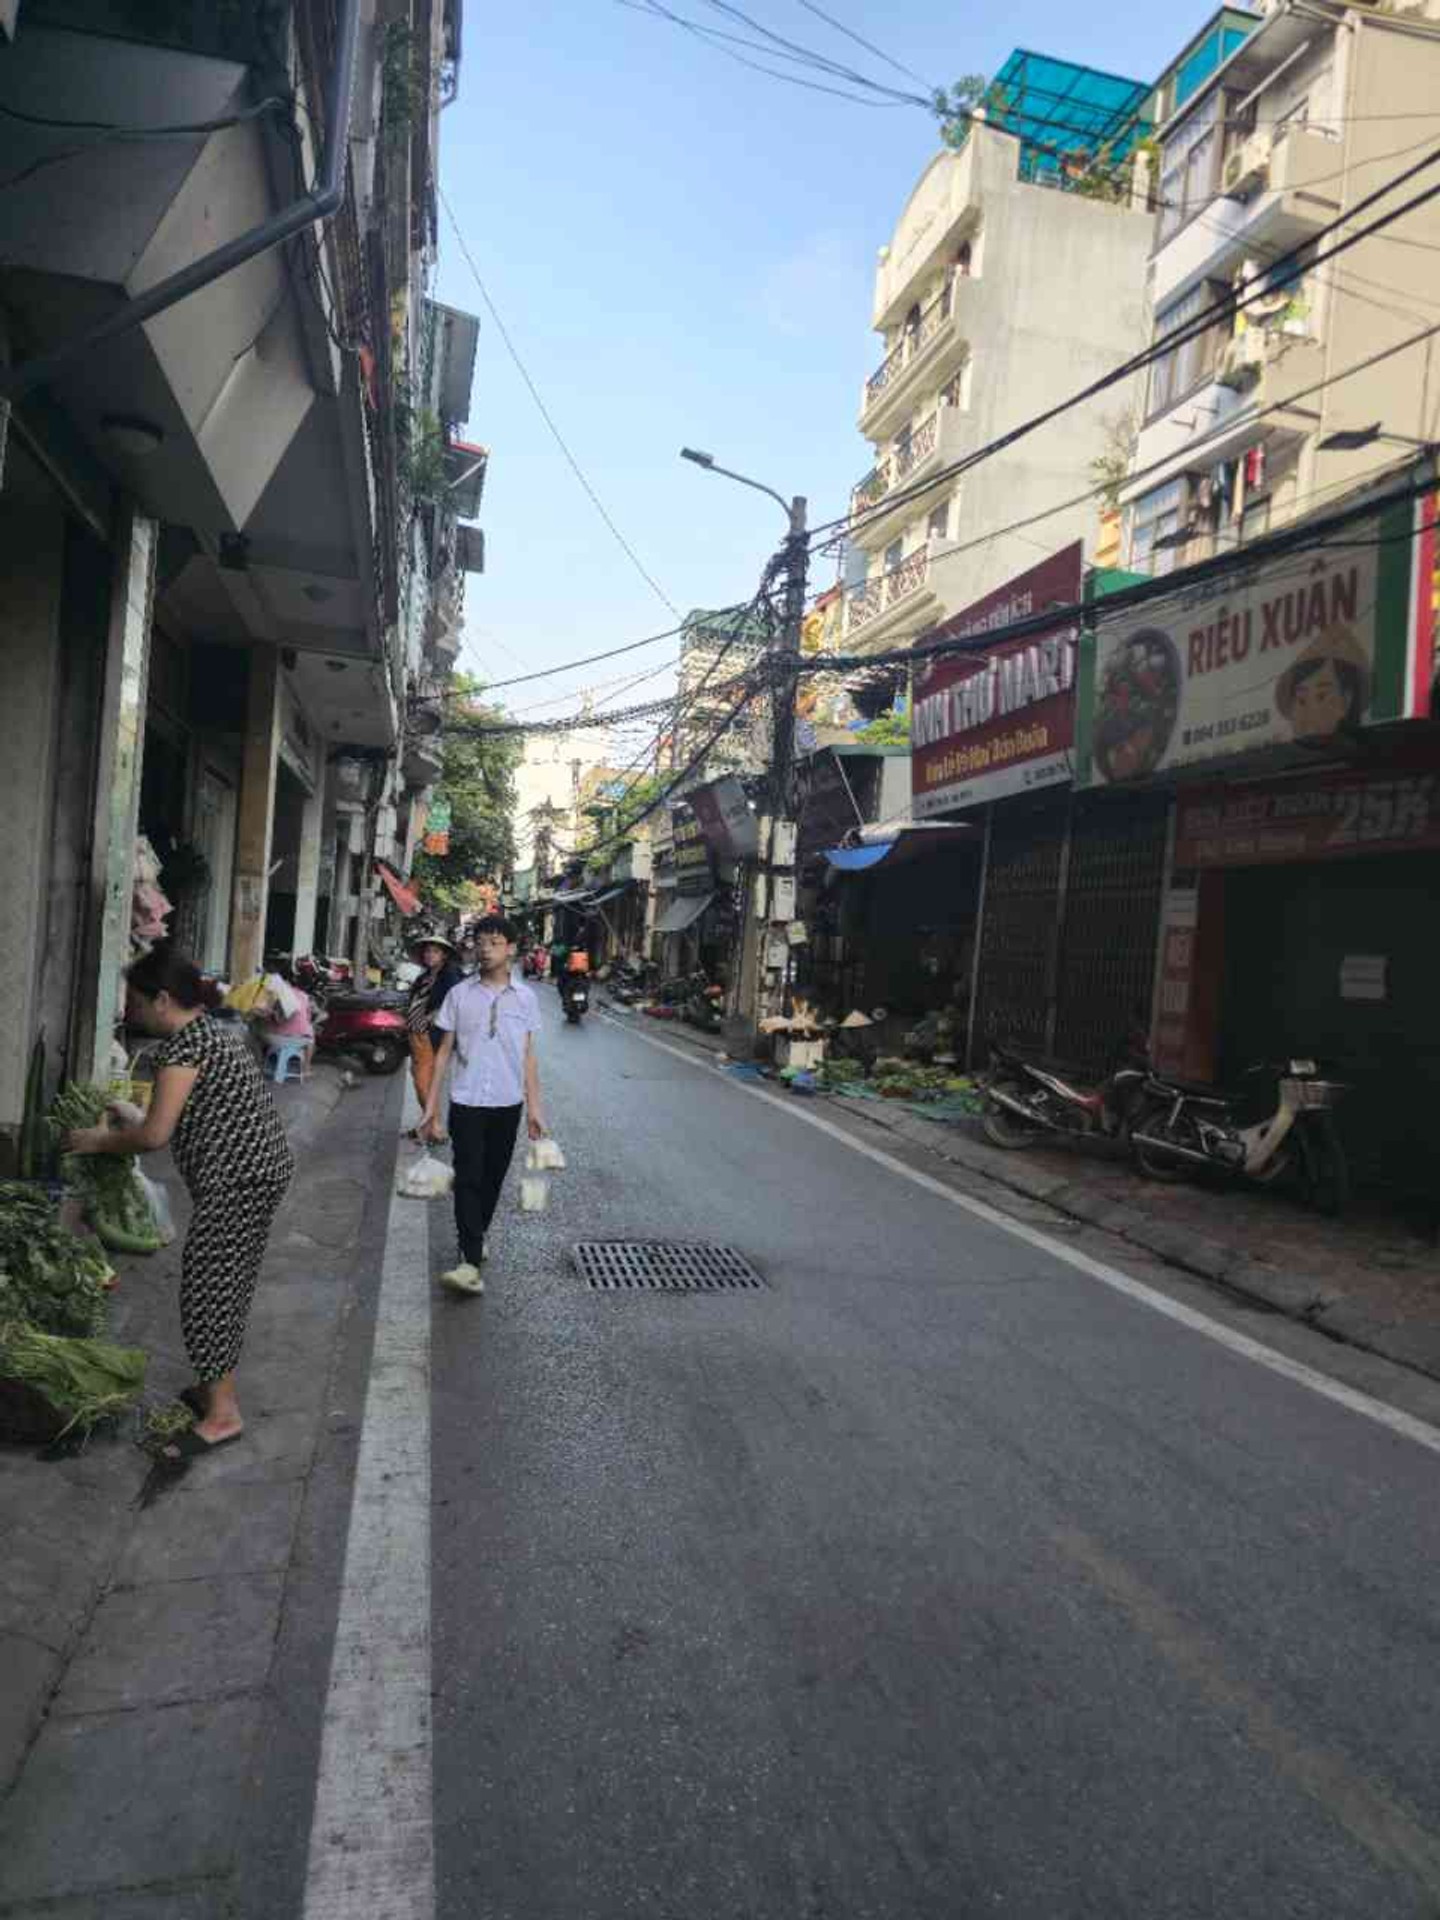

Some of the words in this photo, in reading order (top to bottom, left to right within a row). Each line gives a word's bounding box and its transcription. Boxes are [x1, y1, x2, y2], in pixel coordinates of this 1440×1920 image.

[1188, 606, 1251, 677] RIÊU
[1260, 559, 1358, 653] XUÂN
[999, 630, 1077, 714] MART
